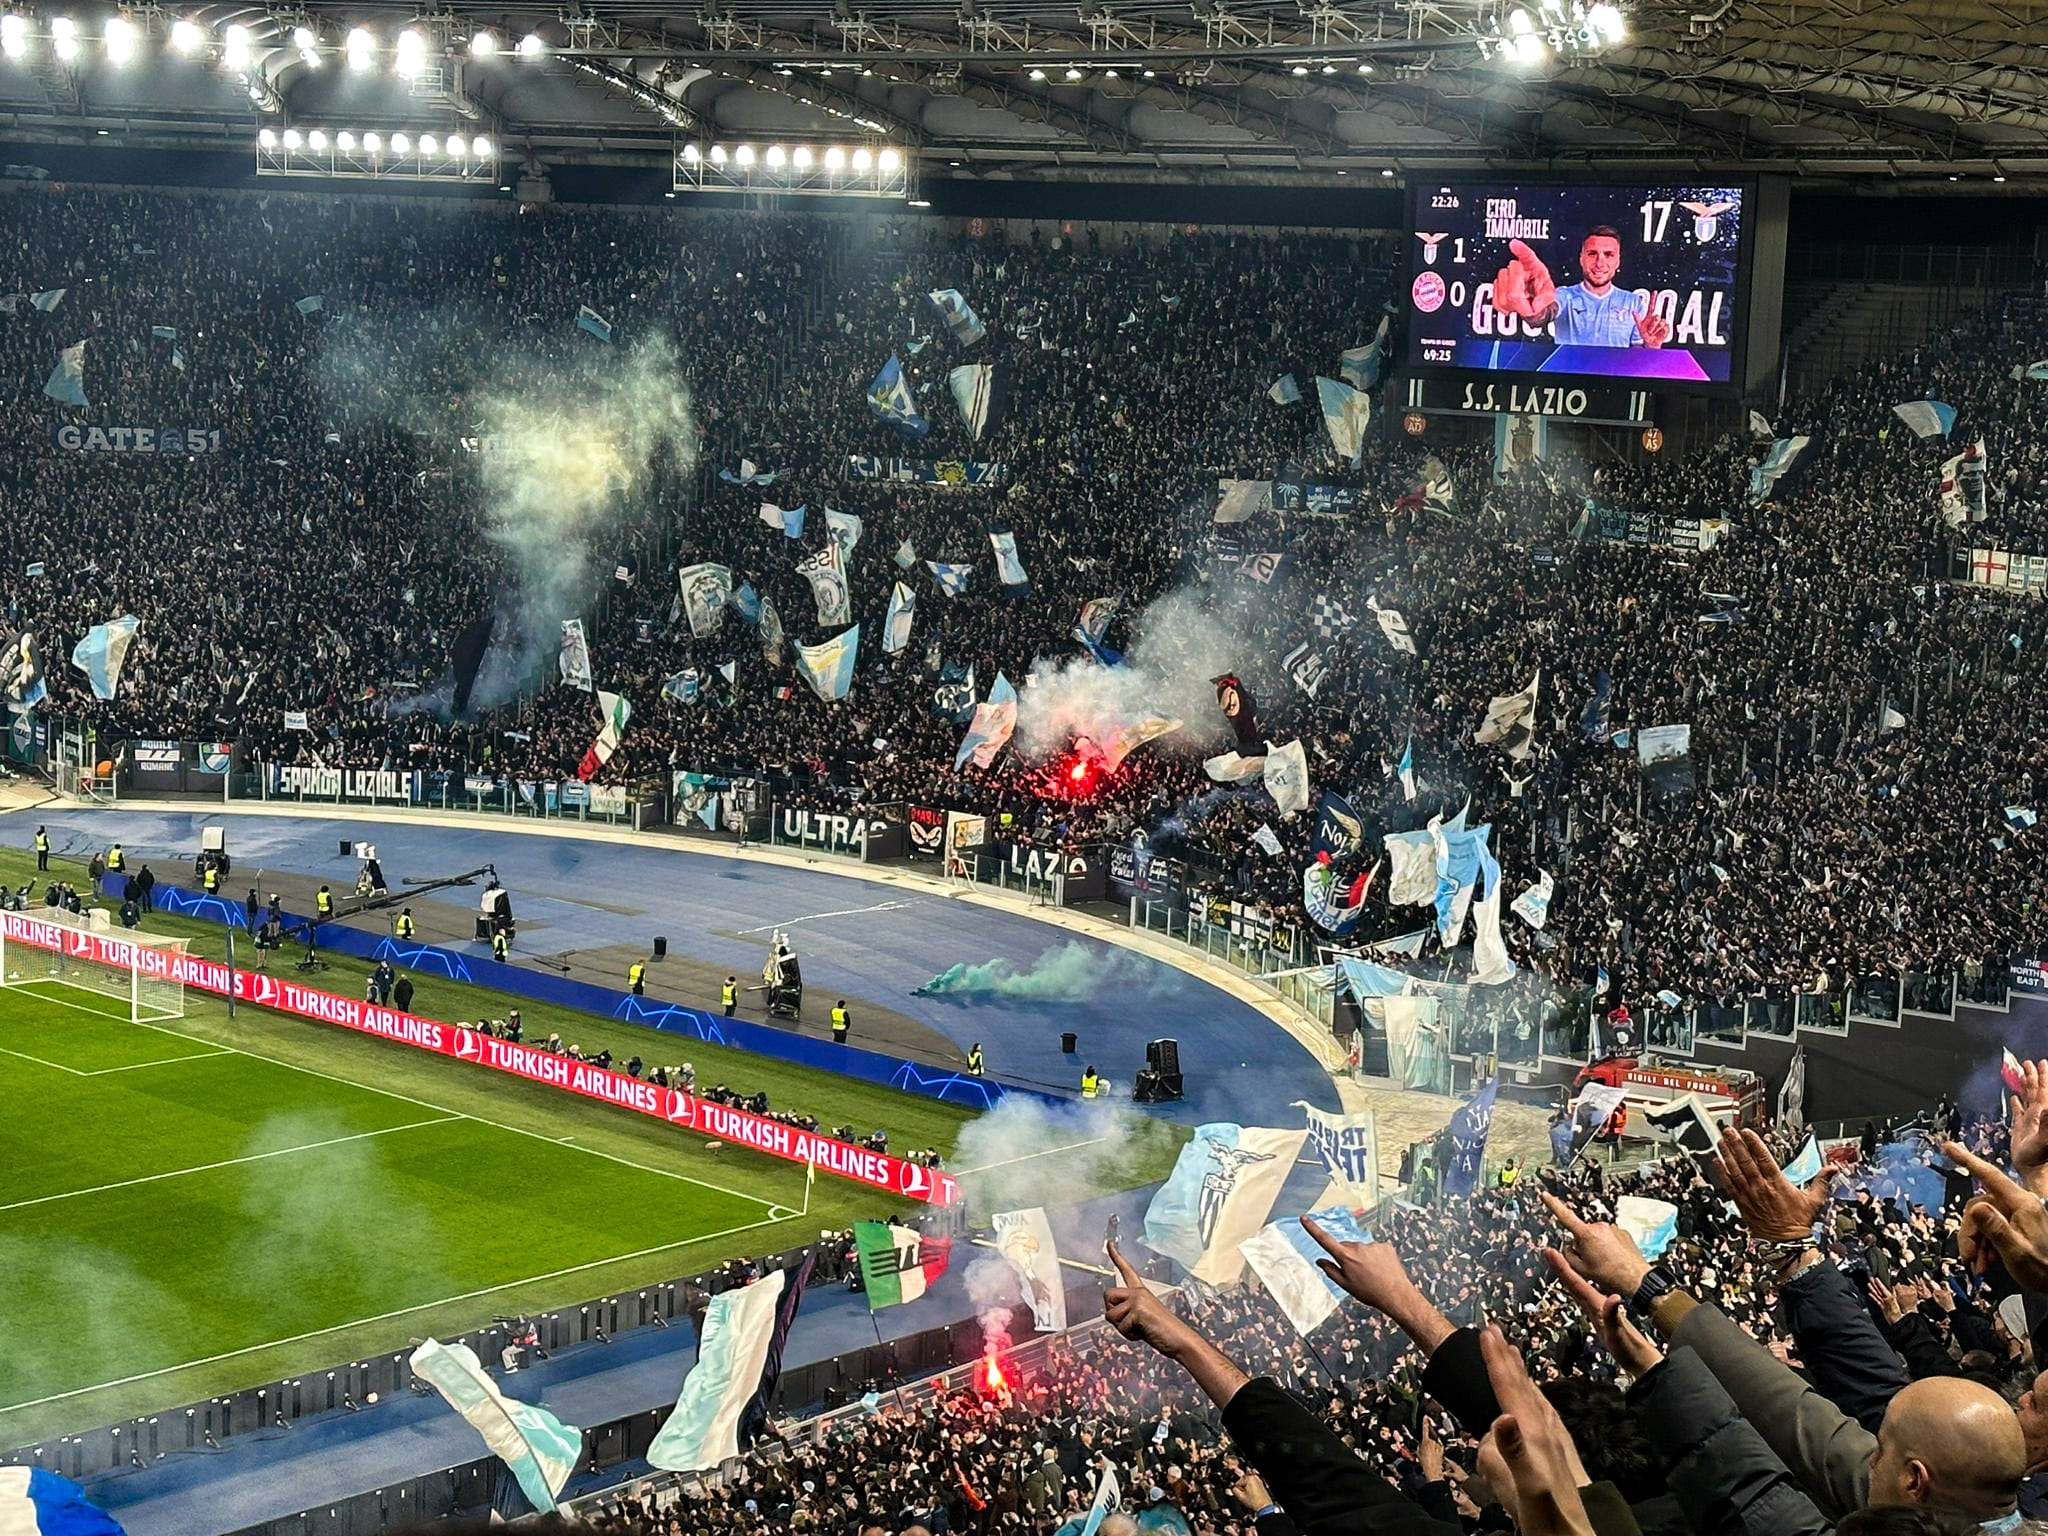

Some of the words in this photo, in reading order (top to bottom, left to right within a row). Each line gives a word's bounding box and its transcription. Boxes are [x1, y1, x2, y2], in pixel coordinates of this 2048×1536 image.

[1431, 196, 1459, 208] 22:26
[1486, 199, 1517, 219] CIRO
[1485, 218, 1550, 239] IMMOBILE
[1640, 200, 1672, 243] 17
[1453, 237, 1467, 263] 1
[1449, 281, 1466, 307] 0
[1423, 349, 1452, 361] 69:25
[1462, 382, 1501, 411] S.S.
[1510, 384, 1587, 415] LAZIO
[57, 425, 155, 452] GATE
[187, 429, 220, 453] 51
[99, 939, 167, 975] TURKISH
[2025, 958, 2041, 969] THE
[2010, 966, 2040, 978] NORTH
[2016, 976, 2040, 987] EAST
[285, 986, 360, 1026] TURKISH
[363, 1007, 443, 1049] AIRLINES
[488, 1040, 569, 1085] TURKISH
[572, 1066, 657, 1112] AIRLINES
[701, 1104, 789, 1154] TURKISH
[794, 1141, 889, 1185] AIRLINES
